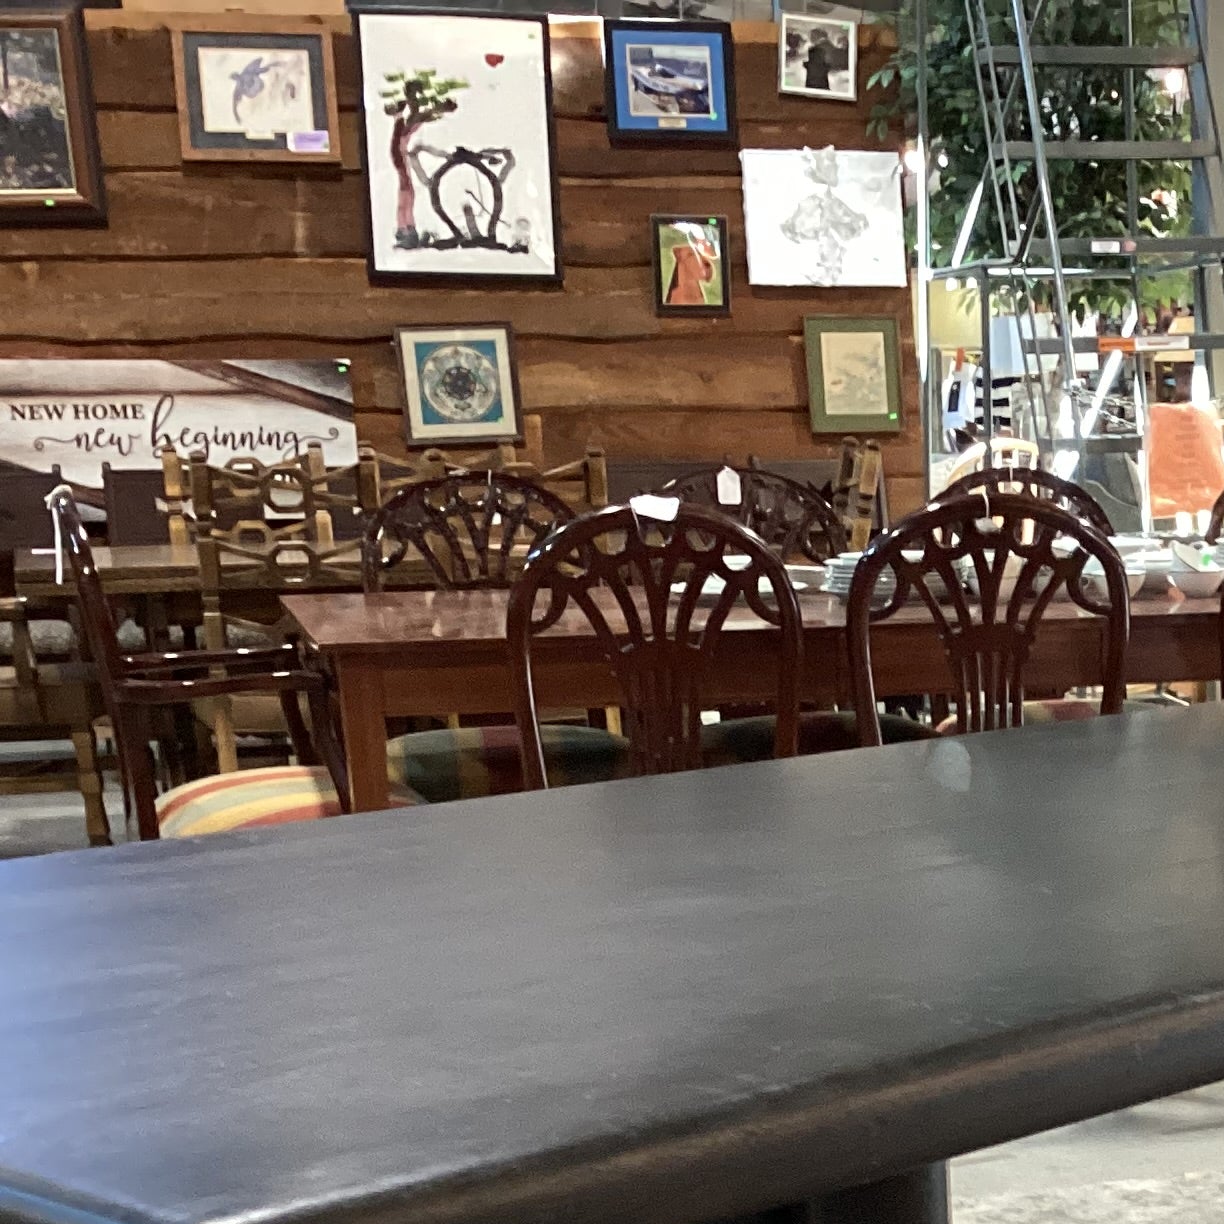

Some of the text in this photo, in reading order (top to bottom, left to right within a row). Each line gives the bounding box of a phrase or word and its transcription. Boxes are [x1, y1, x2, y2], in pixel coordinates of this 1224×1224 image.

[10, 403, 145, 421] NEW HOME
[62, 394, 304, 461] new beginning
